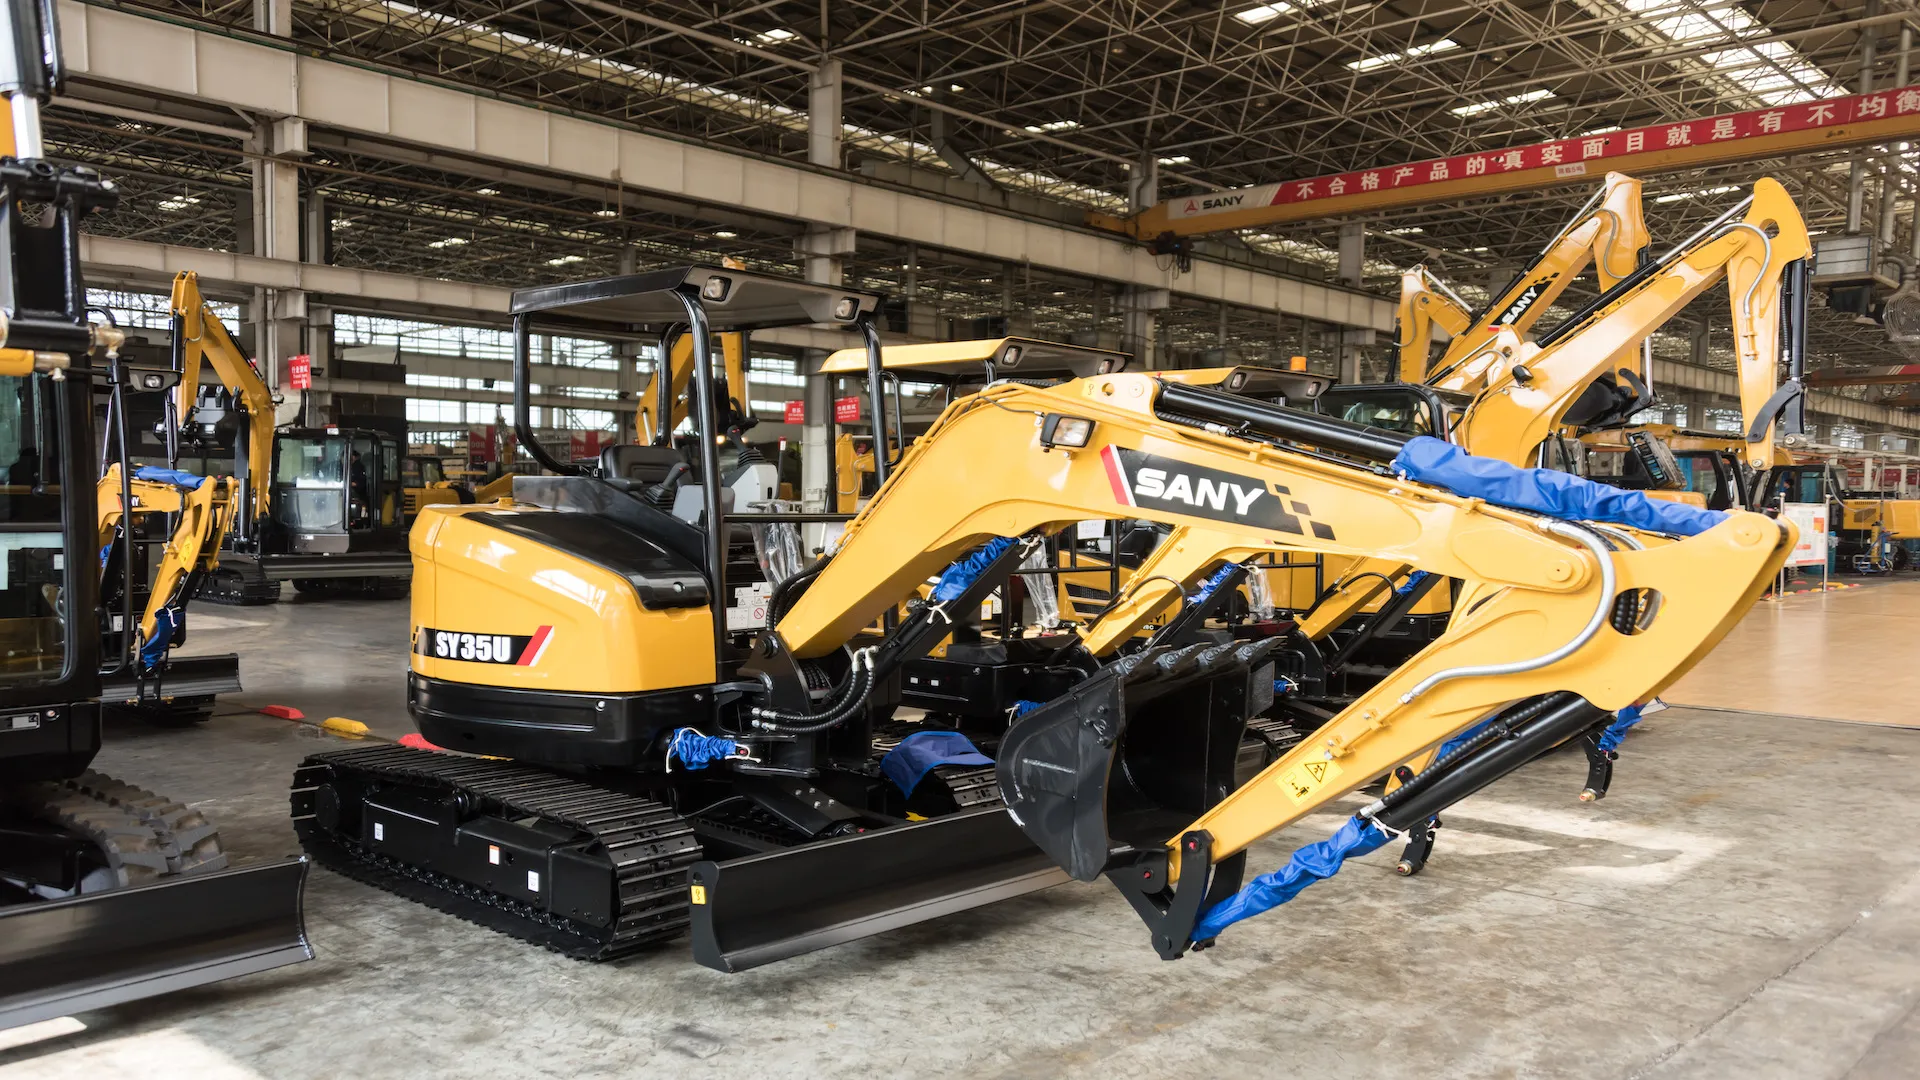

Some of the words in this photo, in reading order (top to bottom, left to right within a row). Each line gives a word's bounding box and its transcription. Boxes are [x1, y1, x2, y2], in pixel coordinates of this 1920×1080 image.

[1202, 195, 1244, 210] SANY
[1501, 286, 1537, 325] SANY
[1134, 467, 1265, 515] SANY
[436, 631, 511, 662] SY35U
